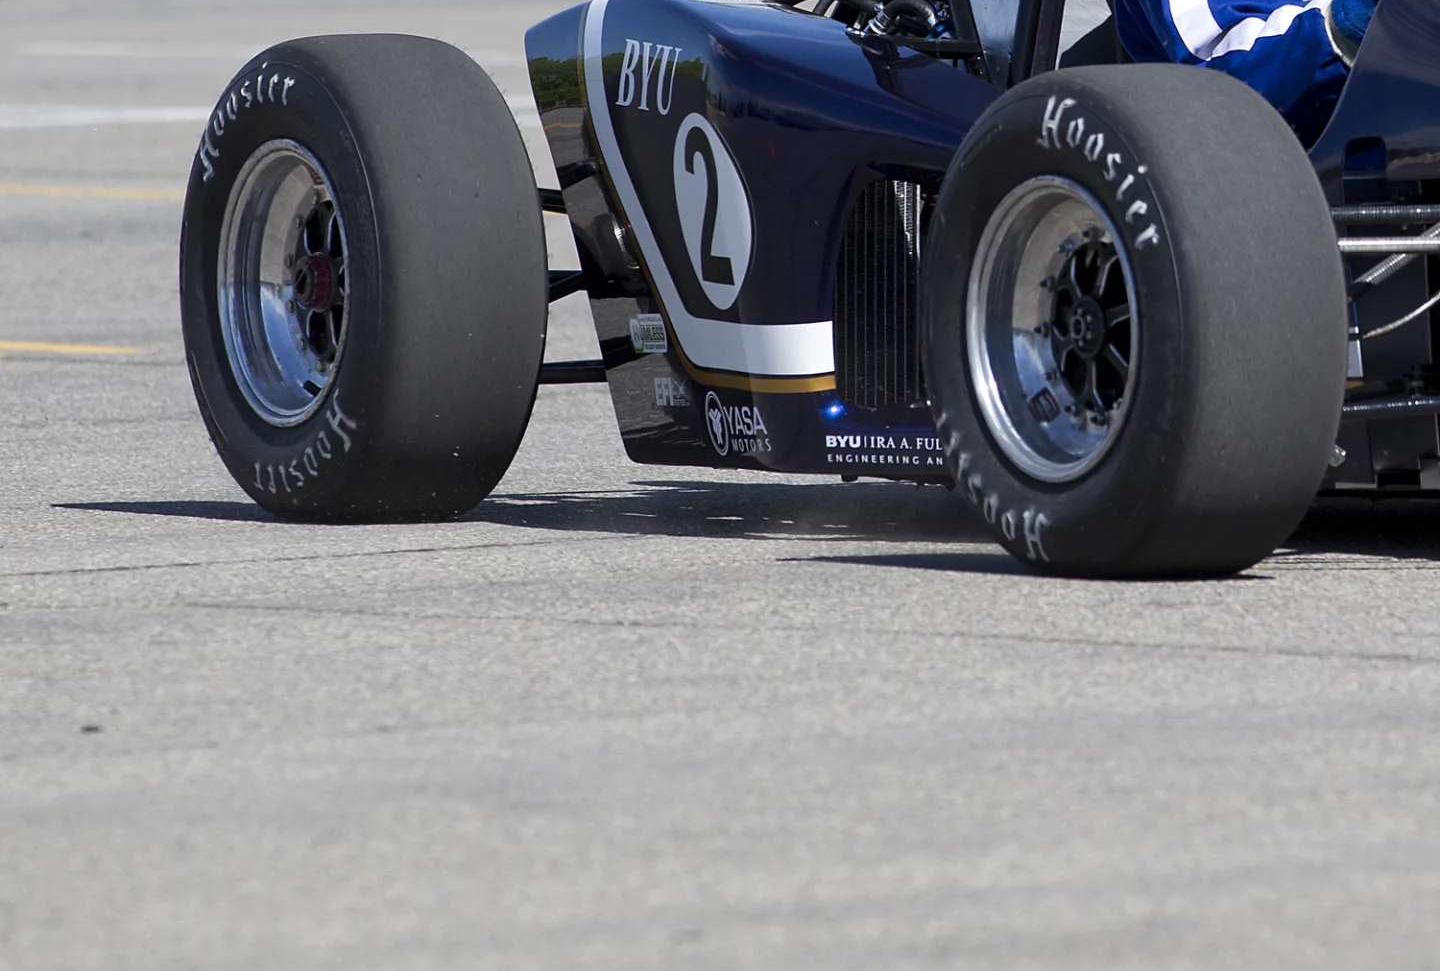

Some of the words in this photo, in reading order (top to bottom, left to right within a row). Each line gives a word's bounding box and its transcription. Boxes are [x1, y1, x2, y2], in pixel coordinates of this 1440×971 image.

[616, 38, 682, 116] BYU
[1036, 94, 1160, 251] Hoosier
[684, 125, 736, 286] 2
[722, 405, 769, 436] YASA
[731, 438, 772, 453] MOTORS
[825, 435, 861, 448] BYU
[870, 436, 896, 449] IRA
[899, 437, 913, 450] A.
[827, 454, 919, 466] ENGINEERING
